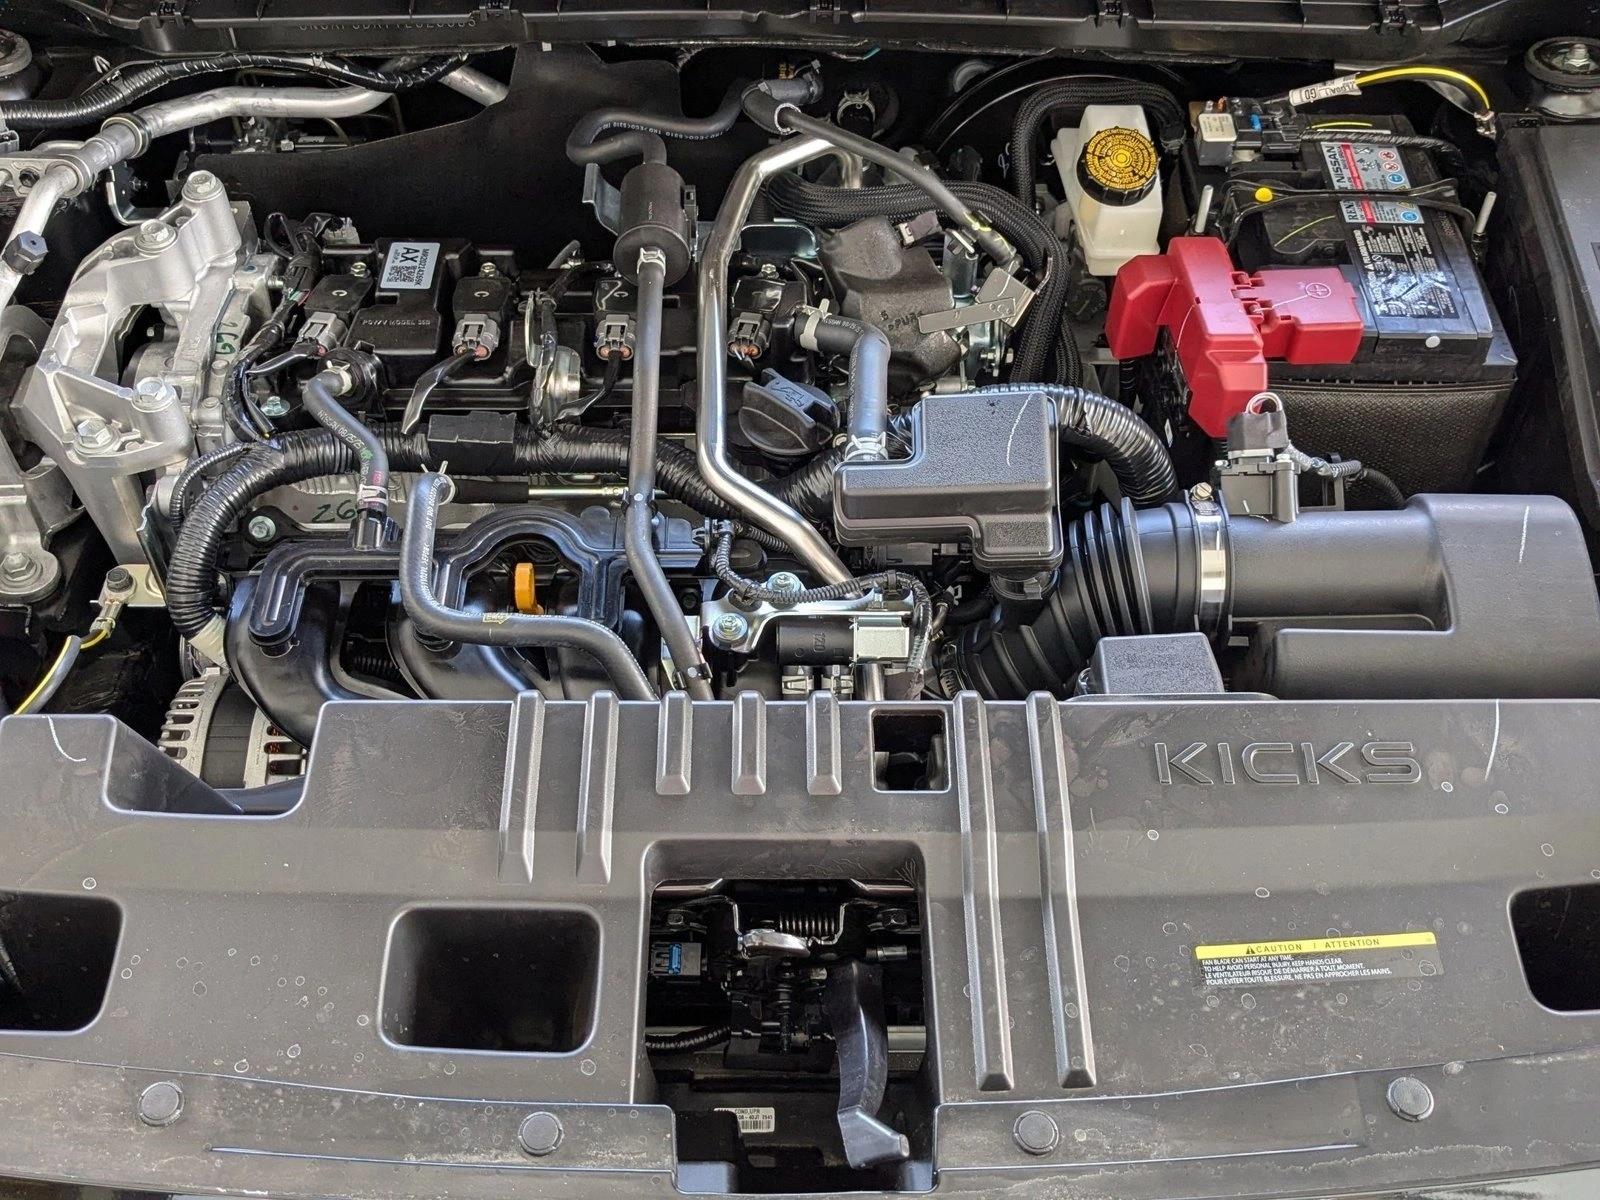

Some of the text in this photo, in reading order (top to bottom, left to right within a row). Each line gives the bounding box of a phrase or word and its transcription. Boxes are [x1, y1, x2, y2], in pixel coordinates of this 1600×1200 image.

[1325, 145, 1346, 184] NISSAN
[400, 247, 420, 263] AX
[1154, 742, 1421, 784] KICKS
[1256, 945, 1302, 953] CAUTION
[1325, 940, 1380, 949] ATTENTION
[1337, 963, 1365, 971] MOMENT.
